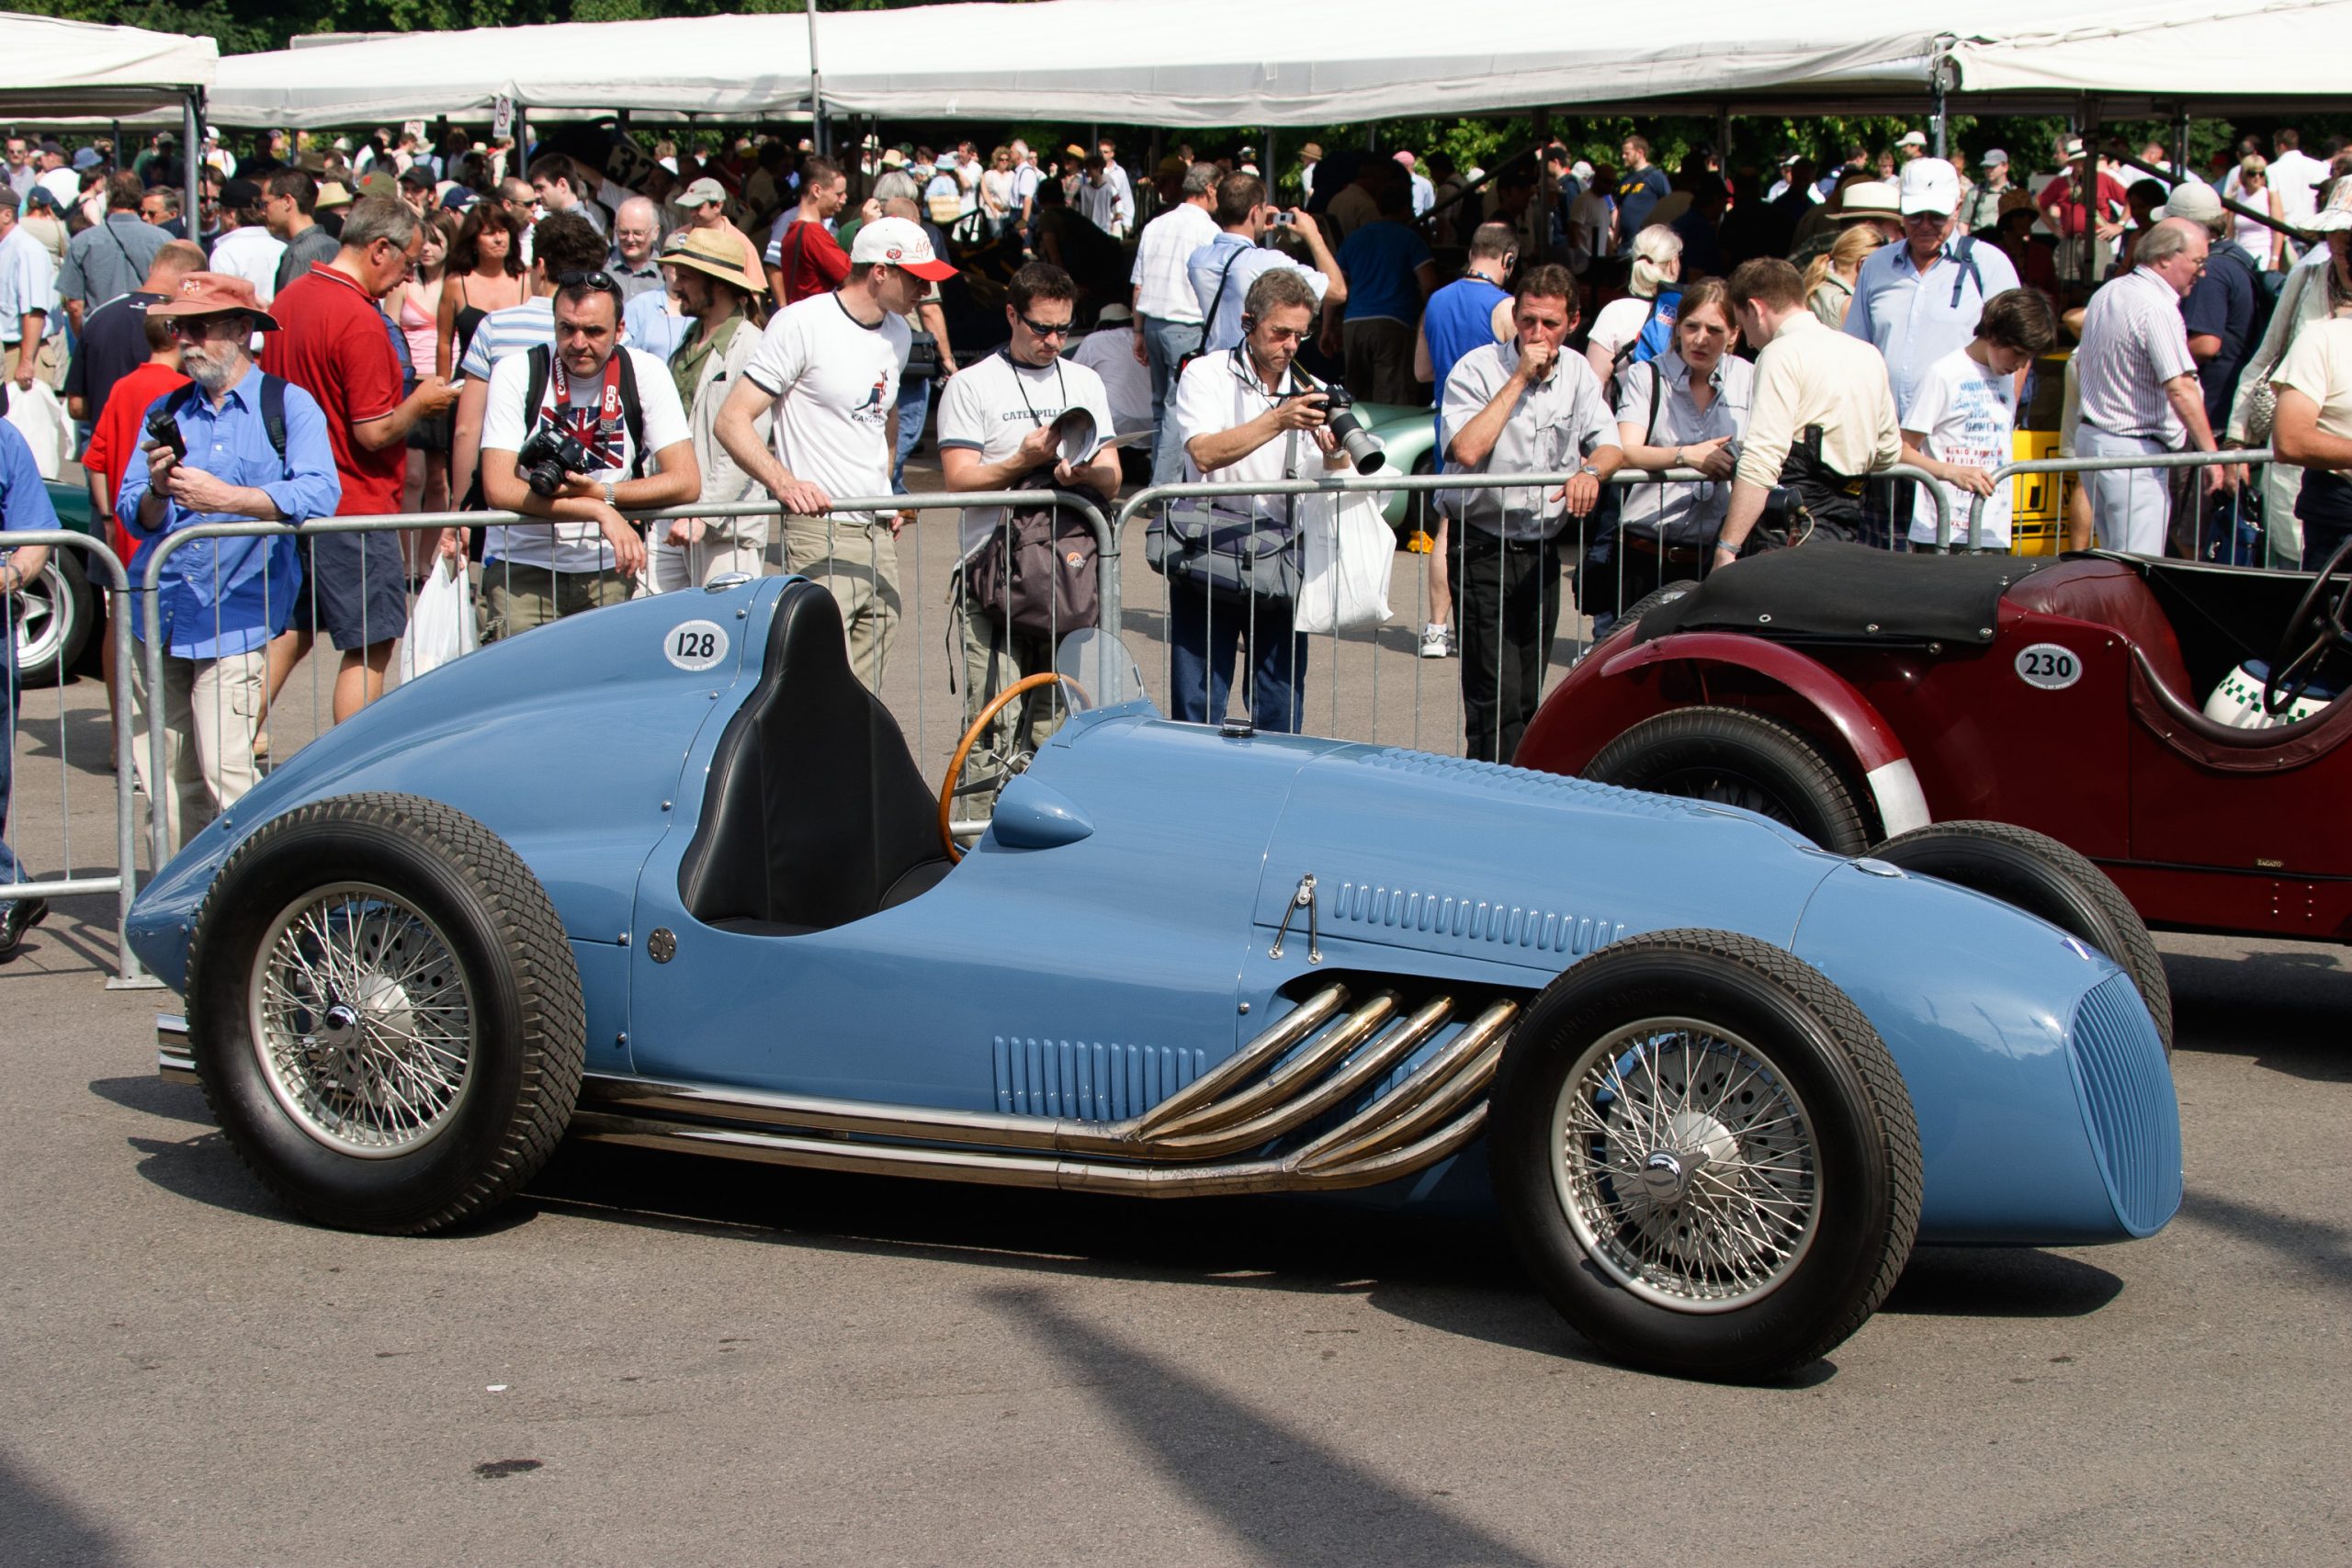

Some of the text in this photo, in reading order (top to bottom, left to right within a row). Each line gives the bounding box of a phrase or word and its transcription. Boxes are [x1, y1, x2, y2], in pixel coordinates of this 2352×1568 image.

[554, 356, 567, 397] Canon
[605, 384, 617, 412] EOS
[1001, 408, 1066, 422] CATEPILL
[676, 632, 715, 658] 128
[2025, 652, 2072, 678] 230
[2256, 859, 2282, 867] ZAGATO
